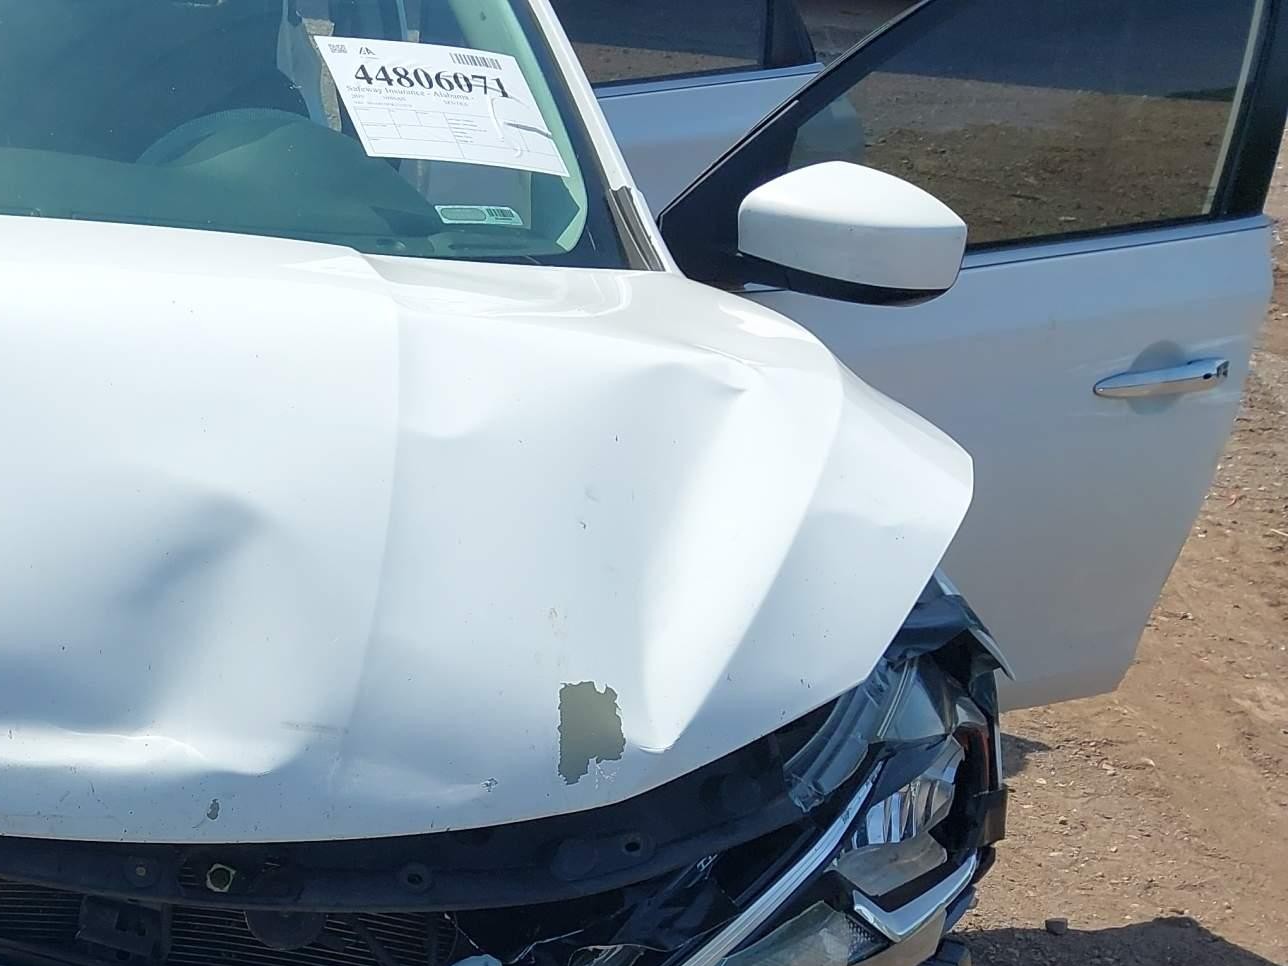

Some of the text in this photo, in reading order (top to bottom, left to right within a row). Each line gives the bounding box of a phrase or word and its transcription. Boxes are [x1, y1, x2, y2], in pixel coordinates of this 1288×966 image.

[346, 85, 382, 95] Safeway
[384, 87, 425, 97] Insurance
[354, 64, 509, 98] 44806071
